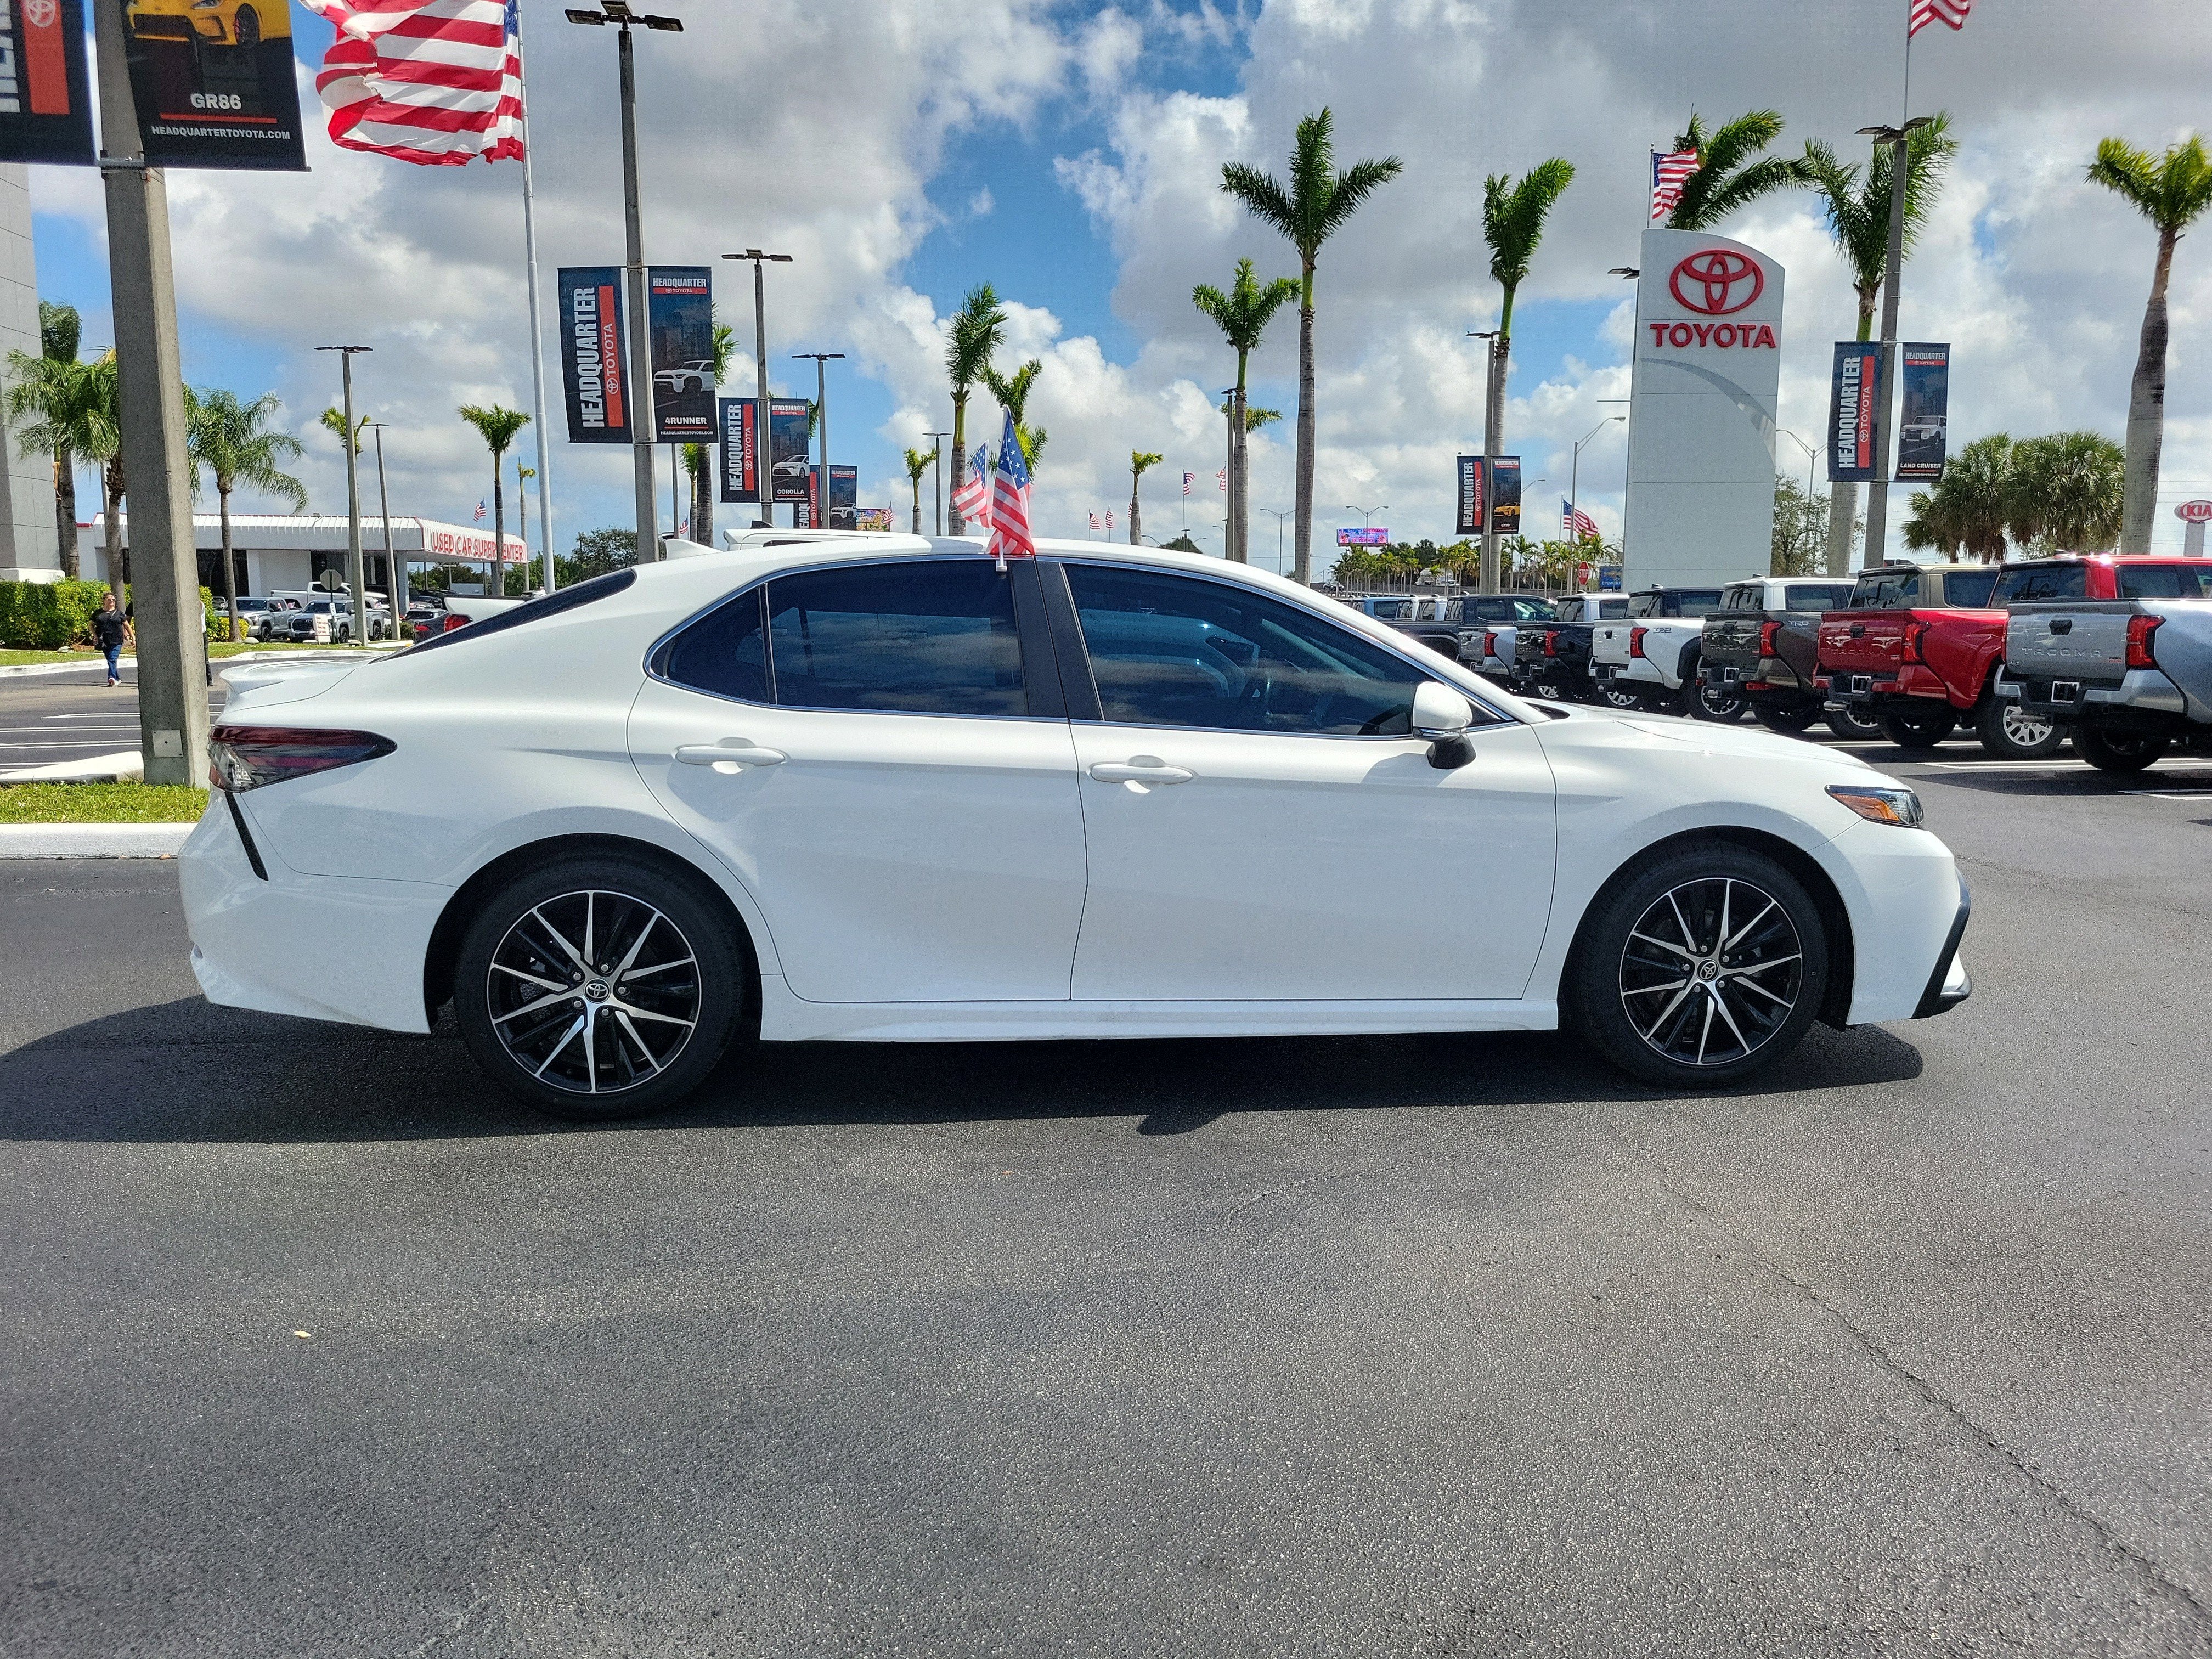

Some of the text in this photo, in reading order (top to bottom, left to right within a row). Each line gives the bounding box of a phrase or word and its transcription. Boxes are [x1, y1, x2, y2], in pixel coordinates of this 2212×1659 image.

[190, 93, 242, 110] GR86
[151, 126, 290, 139] HEADQUARTERTOYOTA.COM
[653, 278, 707, 288] HEADQUARTER
[1650, 323, 1776, 348] TOYOTA
[573, 287, 605, 428] HEADQUARTER
[603, 323, 616, 376] TOYOTA
[1905, 352, 1946, 360] HEADQUARTER
[1838, 356, 1860, 469] HEADQUARTER
[1860, 386, 1870, 429] TOYOTA
[727, 404, 744, 490] HEADQUARTER
[1463, 462, 1475, 527] HEADQUARTER
[2186, 505, 2212, 517] KIA
[432, 531, 523, 561] USED CAR SUPERENTER
[1578, 568, 1588, 578] STOP
[2021, 647, 2102, 658] TACOMA
